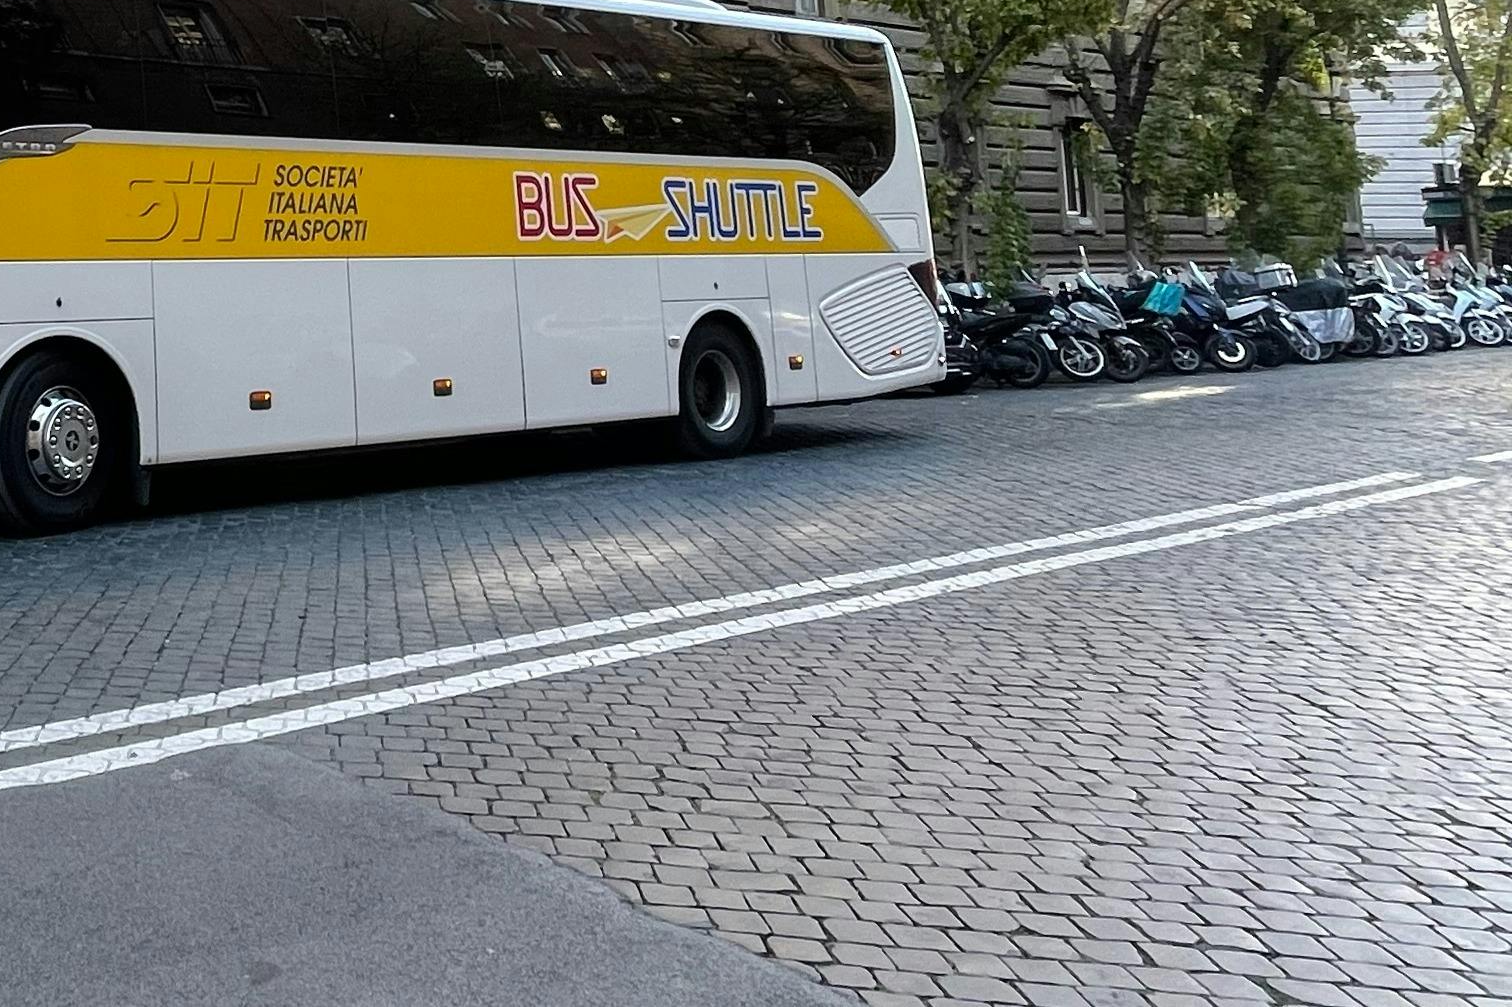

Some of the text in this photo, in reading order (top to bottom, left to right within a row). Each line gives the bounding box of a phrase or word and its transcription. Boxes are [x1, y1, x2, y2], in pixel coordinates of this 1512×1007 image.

[273, 164, 363, 189] SOCIETA'
[267, 192, 359, 215] ITALIANA
[514, 173, 823, 240] BUS SHUTTLE
[263, 219, 368, 242] TRASPORTI
